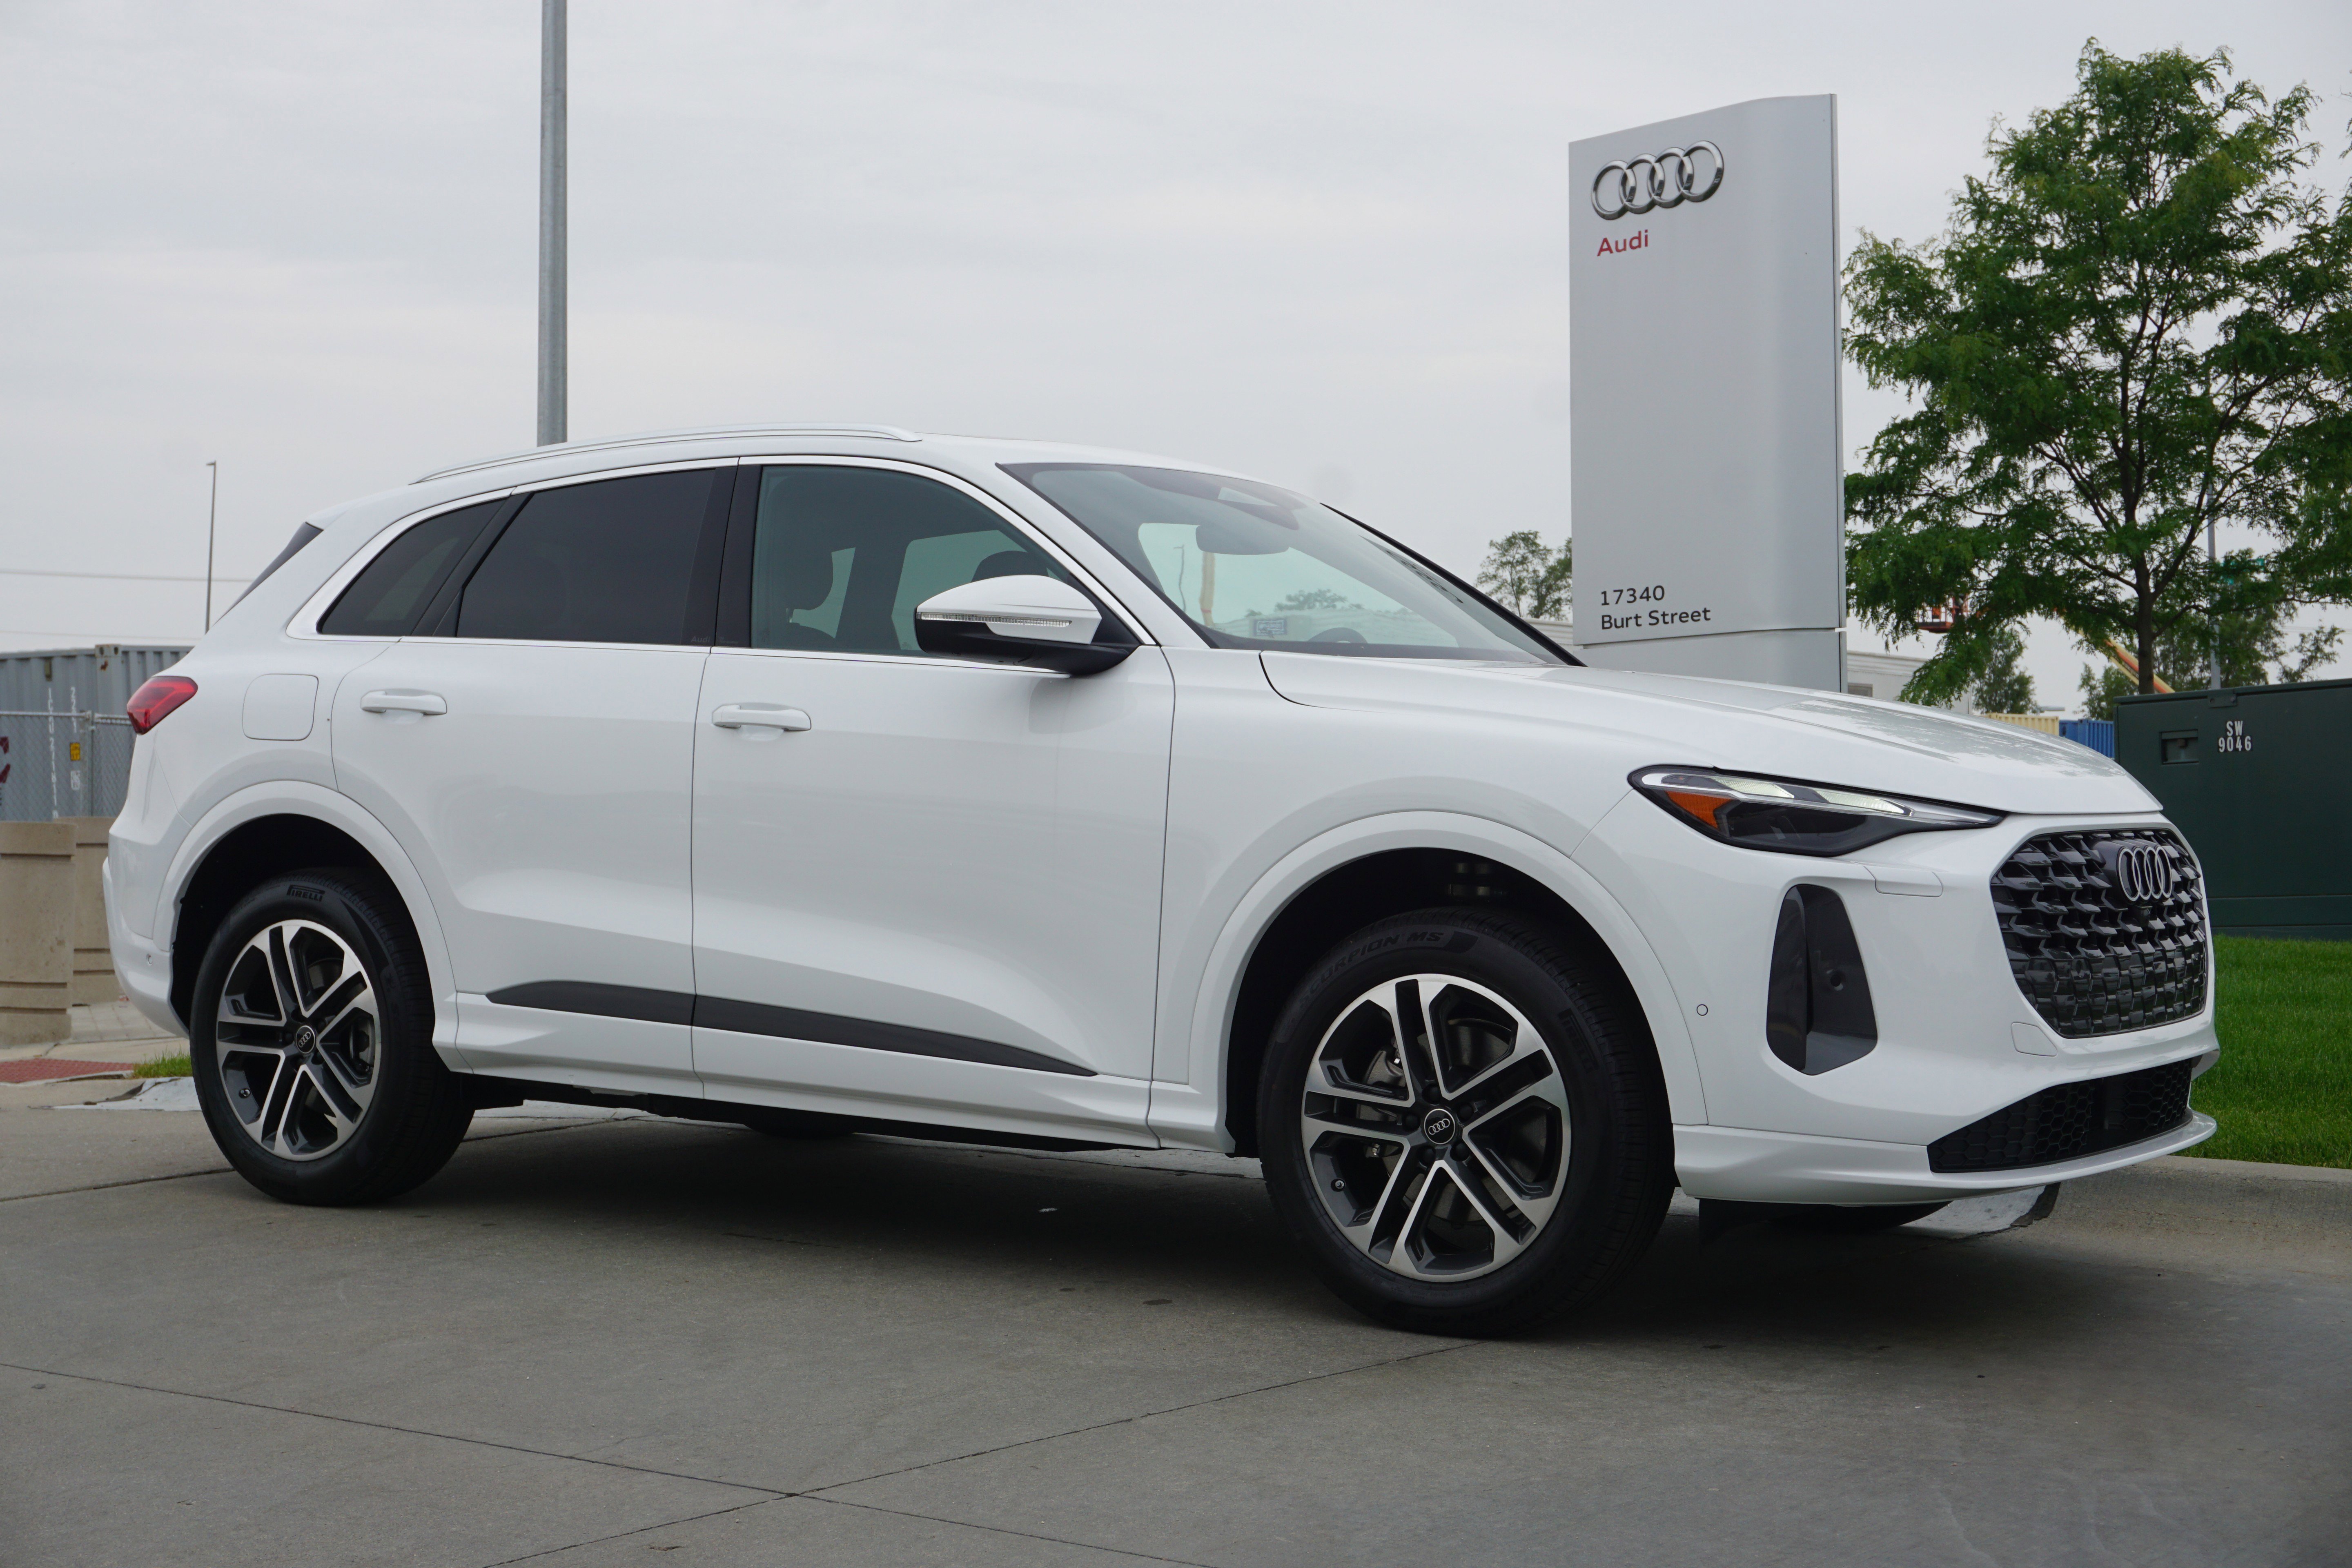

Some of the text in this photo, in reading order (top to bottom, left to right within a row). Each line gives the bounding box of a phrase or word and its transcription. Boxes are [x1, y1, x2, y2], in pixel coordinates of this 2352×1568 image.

[1597, 229, 1649, 257] Audi
[1601, 585, 1665, 606] 17340
[1601, 607, 1711, 630] Burt Street
[2226, 720, 2243, 736] SW
[2218, 736, 2252, 753] 9046
[286, 884, 326, 902] PIRELLI
[1407, 931, 1445, 942] MS
